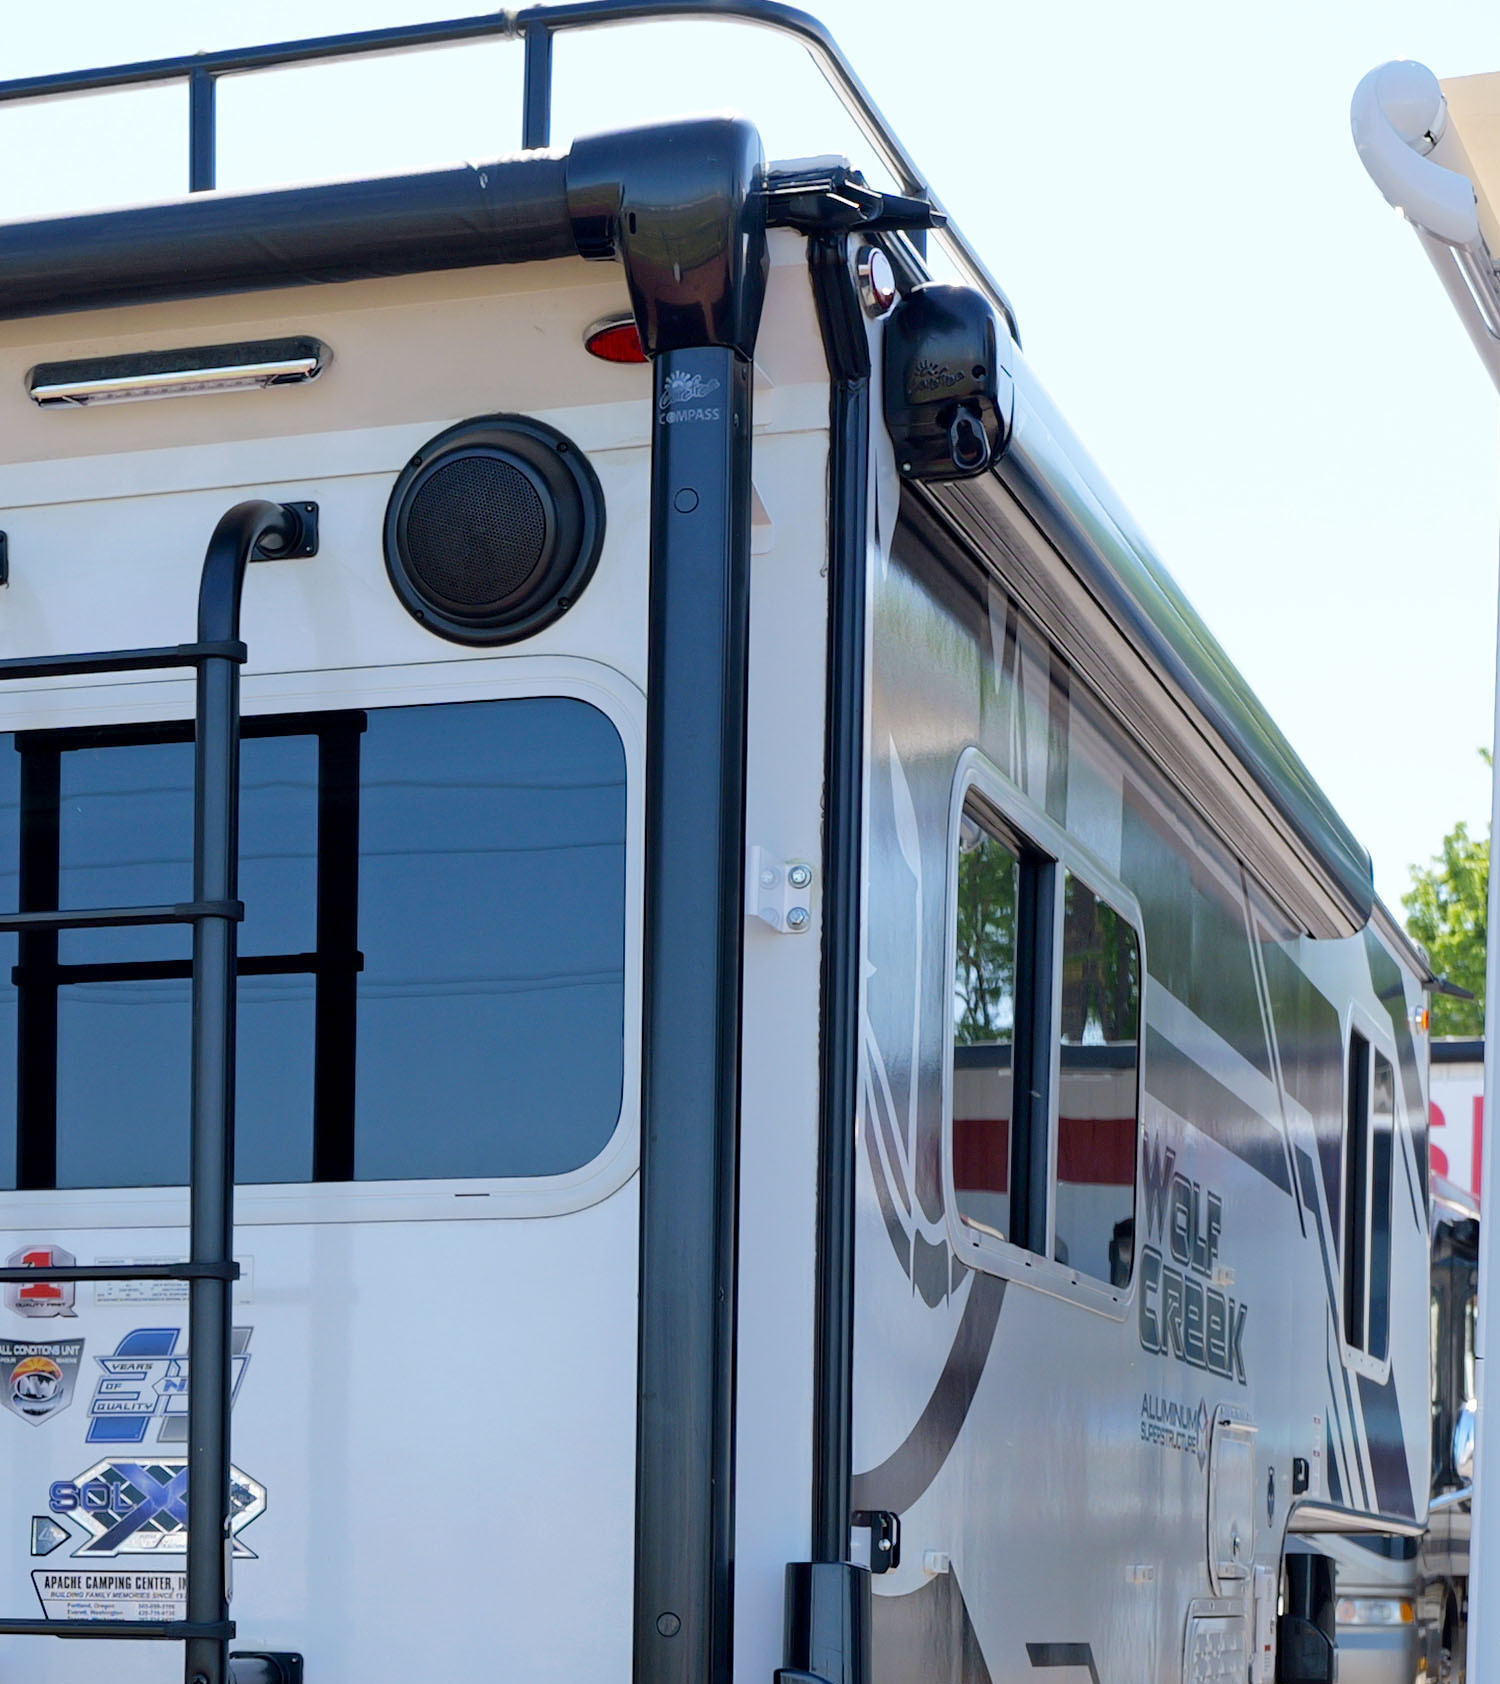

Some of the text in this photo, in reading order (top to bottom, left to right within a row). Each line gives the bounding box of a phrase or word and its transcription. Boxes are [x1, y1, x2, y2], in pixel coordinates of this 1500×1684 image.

[659, 408, 720, 424] COMPASS
[1142, 1131, 1222, 1280] WOLF
[13, 1345, 60, 1356] CONDITIONS
[61, 1345, 80, 1355] UNIT
[163, 1379, 187, 1391] N
[1141, 1393, 1198, 1432] ALUMINUM
[1141, 1421, 1197, 1455] SUPERSTRUCTURE
[44, 1576, 82, 1590] APACHE
[85, 1576, 132, 1590] CAMPING
[135, 1576, 175, 1591] CENTER,
[112, 1591, 150, 1599] MEMORIES
